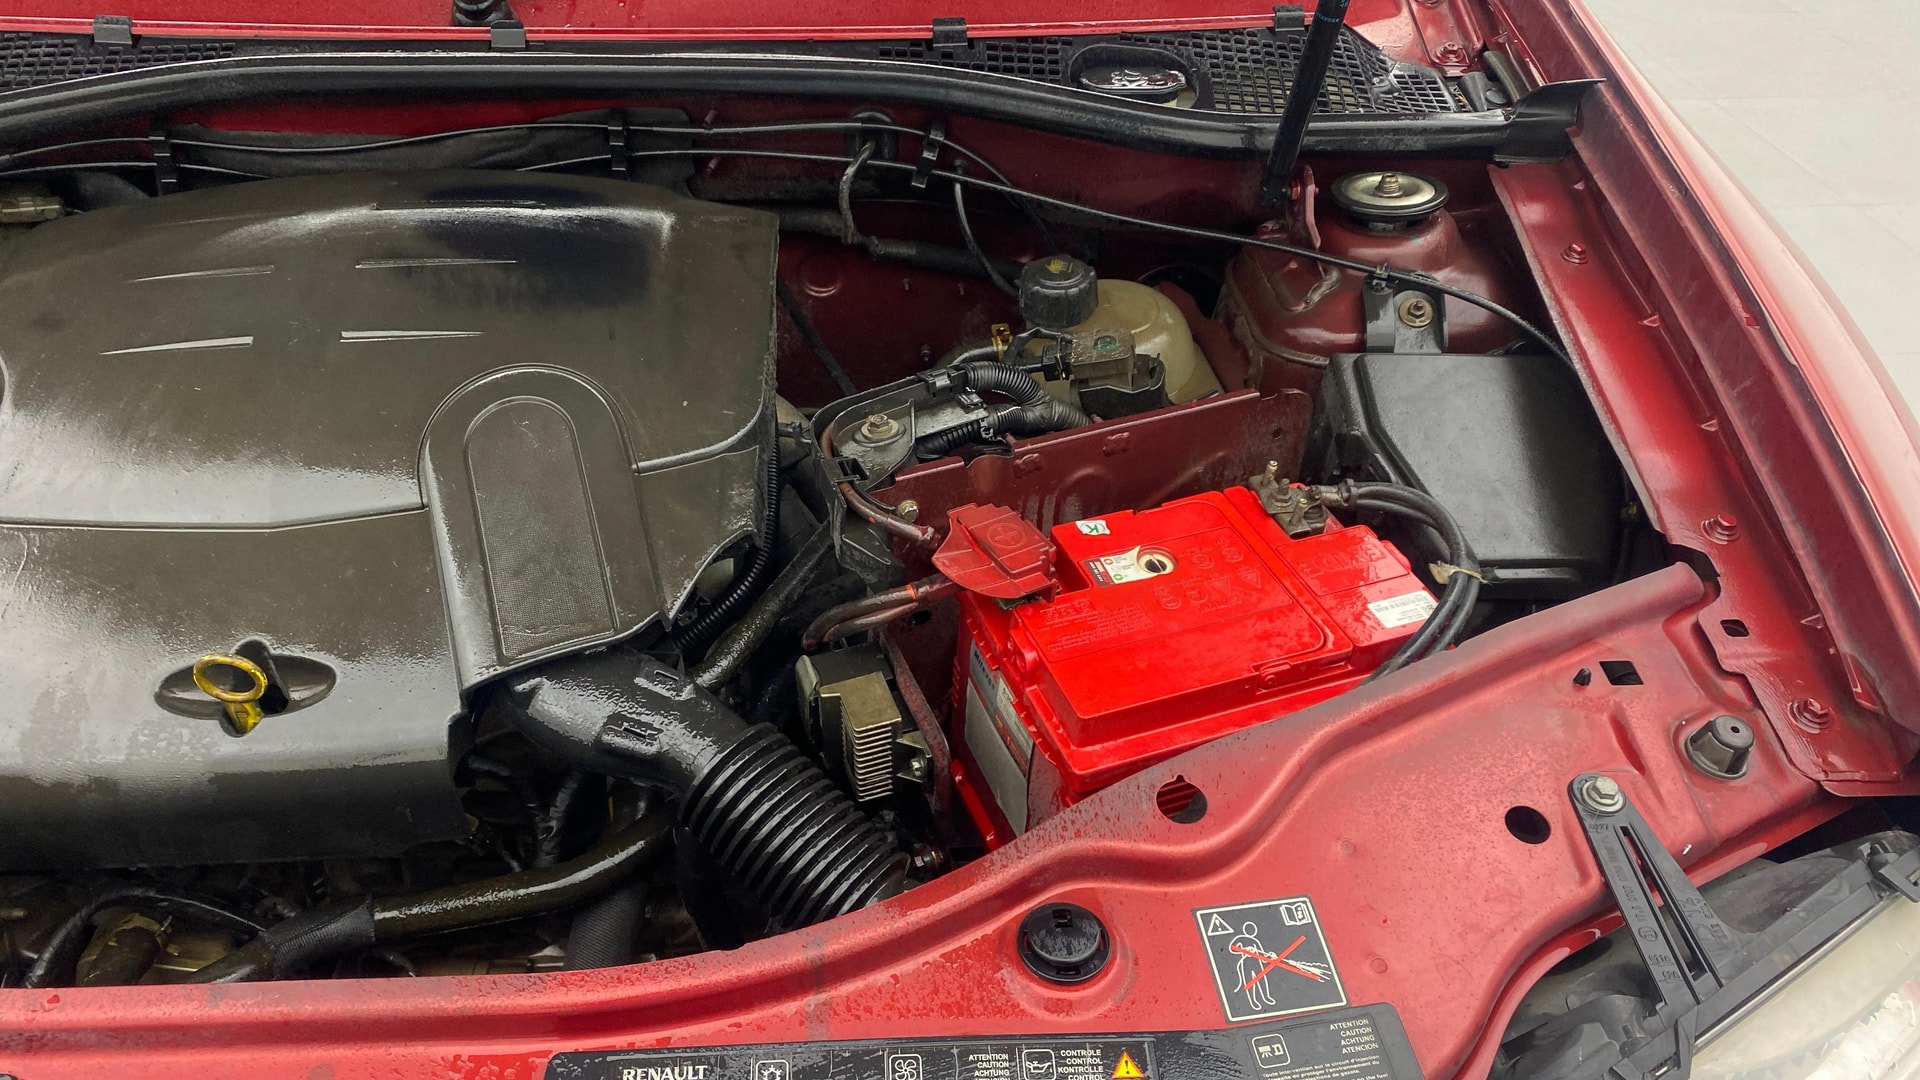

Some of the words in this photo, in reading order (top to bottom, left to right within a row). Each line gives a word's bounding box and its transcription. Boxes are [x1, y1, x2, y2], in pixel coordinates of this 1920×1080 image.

[1330, 1018, 1369, 1031] ATTENTION
[1340, 1026, 1373, 1037] CAUTION
[1341, 1034, 1376, 1046] ACHTUNG
[1342, 1042, 1379, 1054] ATENCION
[968, 1053, 1009, 1061] ATTENTION
[1060, 1049, 1102, 1057] CONTROLE
[977, 1061, 1009, 1069] CAUTION
[1066, 1057, 1104, 1065] CONTROL
[622, 1065, 708, 1080] RENAULT
[974, 1069, 1010, 1077] ACHTUNG
[1057, 1065, 1104, 1074] KONTROLLE
